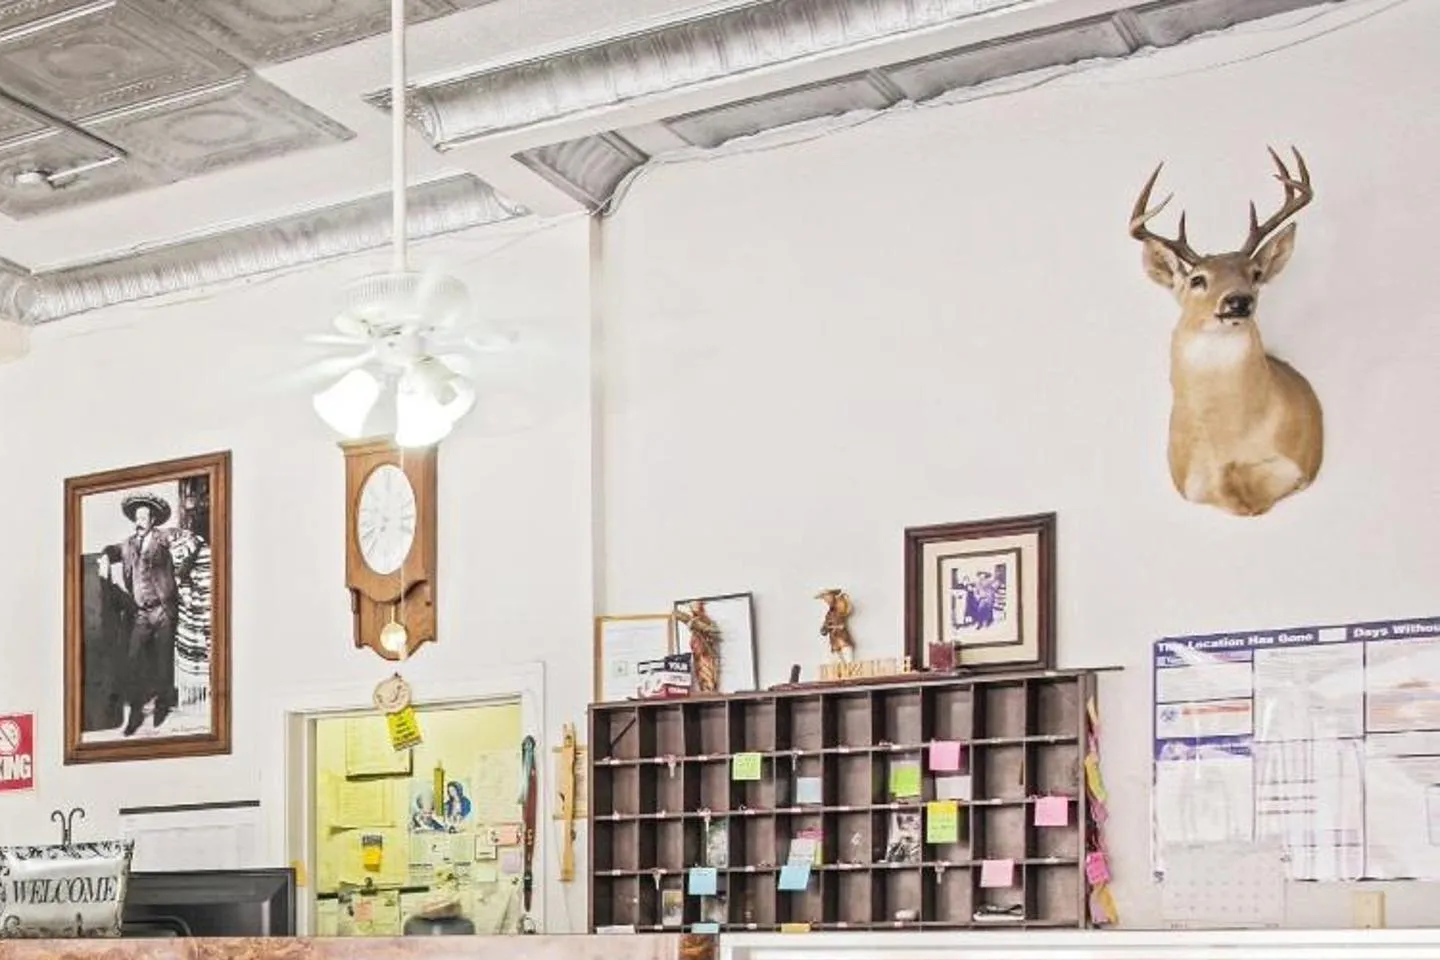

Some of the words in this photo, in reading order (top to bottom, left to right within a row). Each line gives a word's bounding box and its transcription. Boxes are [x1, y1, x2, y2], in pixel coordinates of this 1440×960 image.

[1188, 637, 1244, 649] Location
[1248, 635, 1274, 645] Has
[1278, 632, 1313, 643] Gone
[1353, 627, 1388, 638] Days
[1392, 623, 1440, 634] Withou
[11, 876, 119, 905] WELCOME
